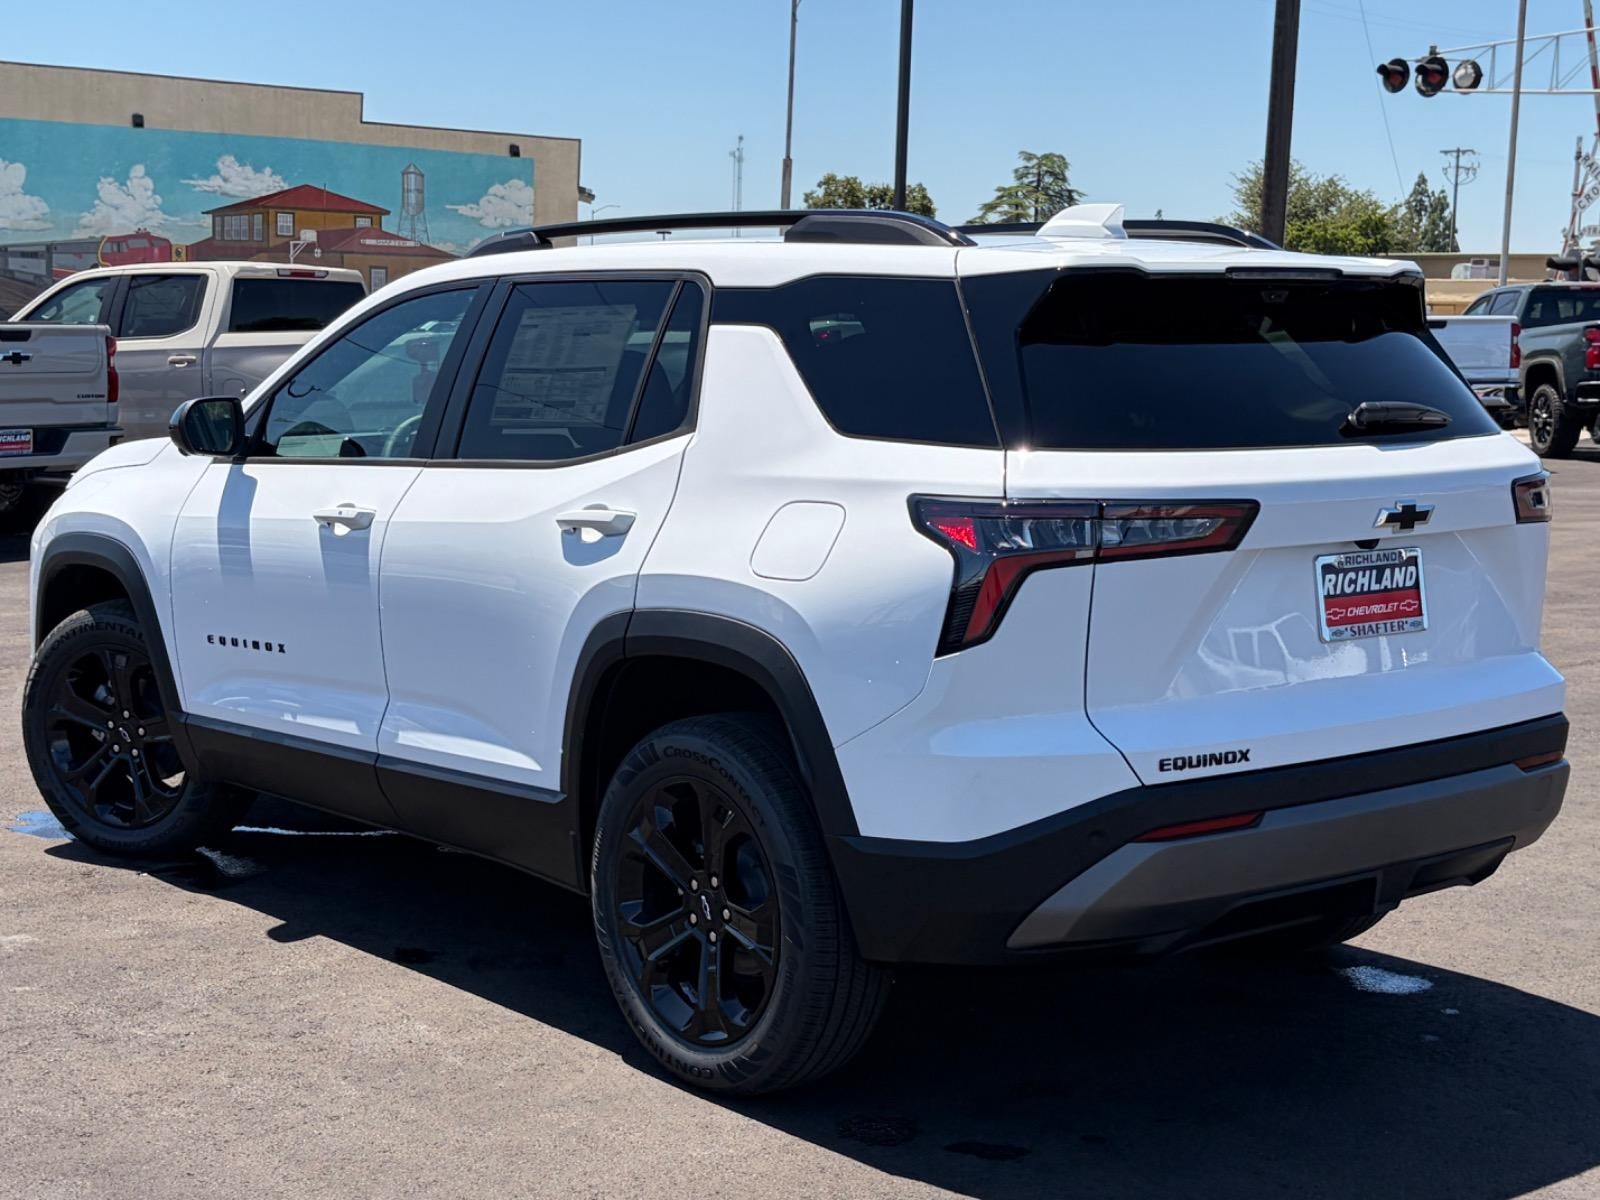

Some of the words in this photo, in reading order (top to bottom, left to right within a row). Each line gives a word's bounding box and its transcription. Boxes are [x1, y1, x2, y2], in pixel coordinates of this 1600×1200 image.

[1344, 551, 1398, 566] RICHLAND
[1323, 566, 1417, 596] RICHLAND
[1347, 602, 1400, 617] CHEVROLET
[206, 634, 286, 654] EQUINOX
[1158, 748, 1250, 772] EQUINOX
